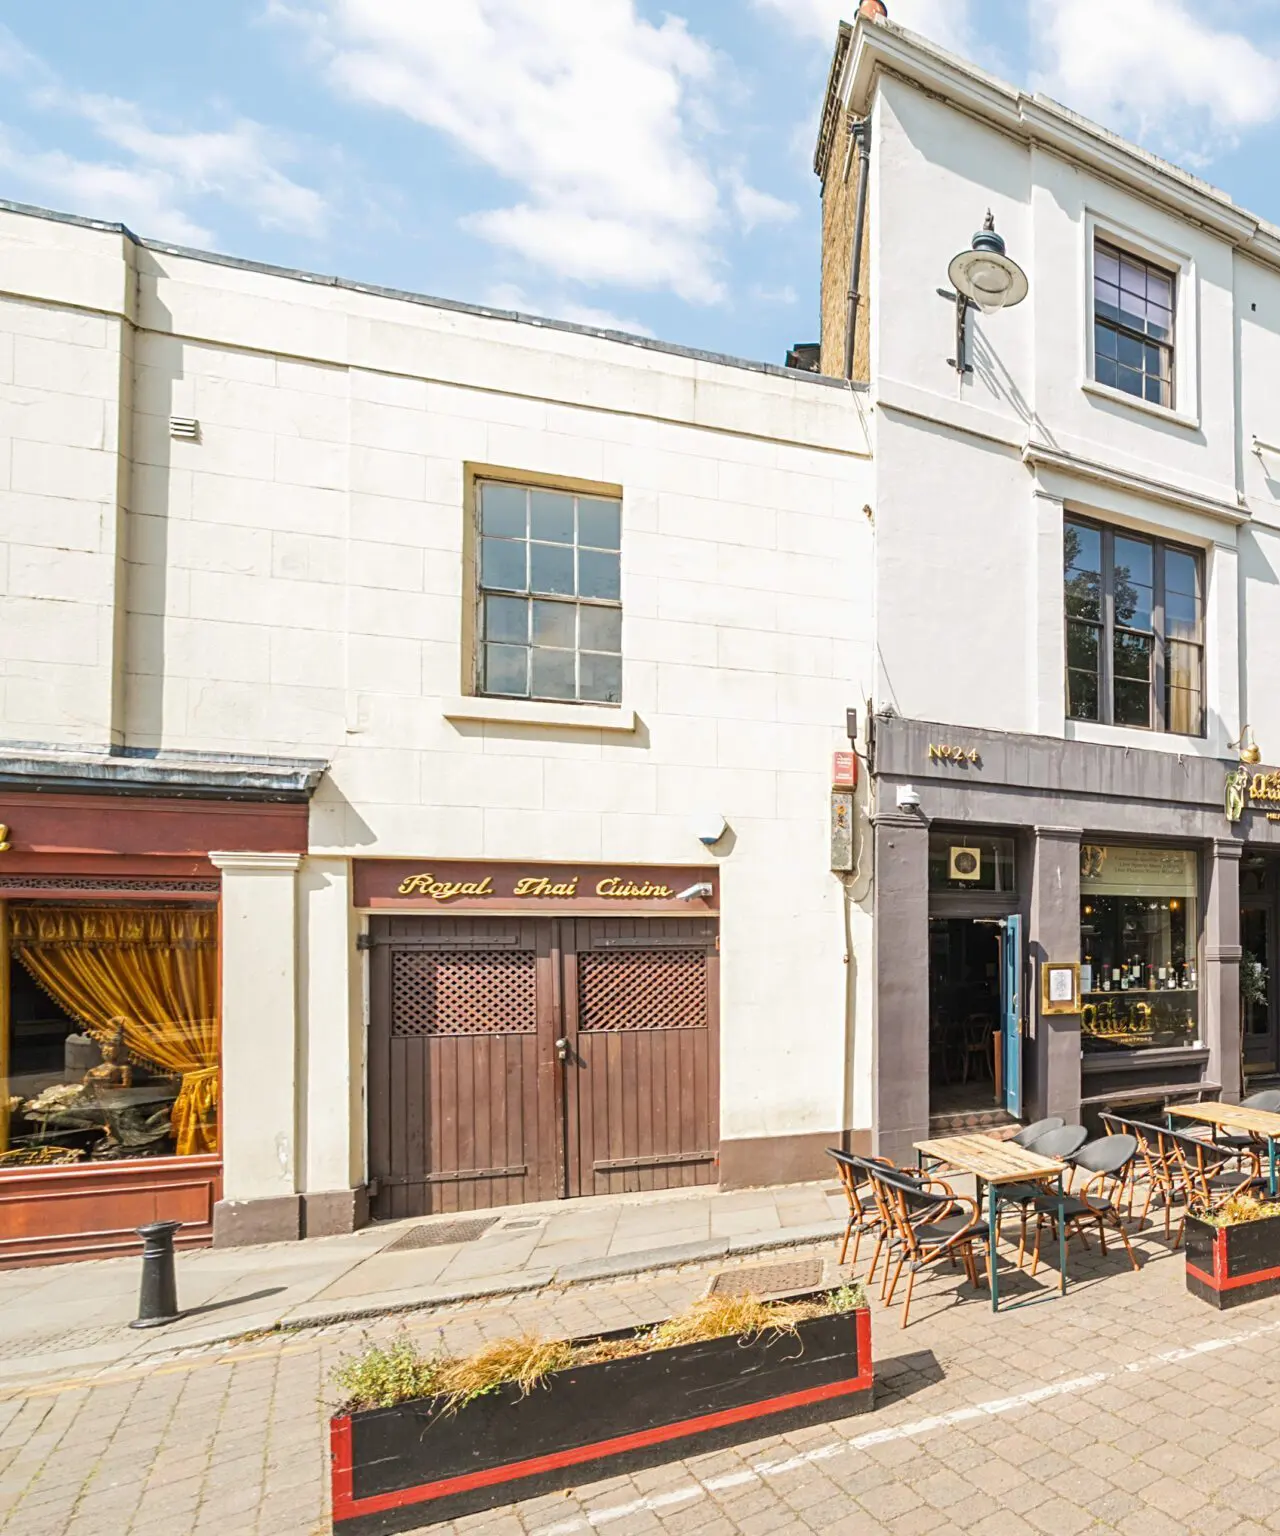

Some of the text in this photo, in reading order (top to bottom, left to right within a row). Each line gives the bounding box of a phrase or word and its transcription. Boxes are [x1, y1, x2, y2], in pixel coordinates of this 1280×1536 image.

[398, 872, 674, 899] Royal Thai Cuisine
